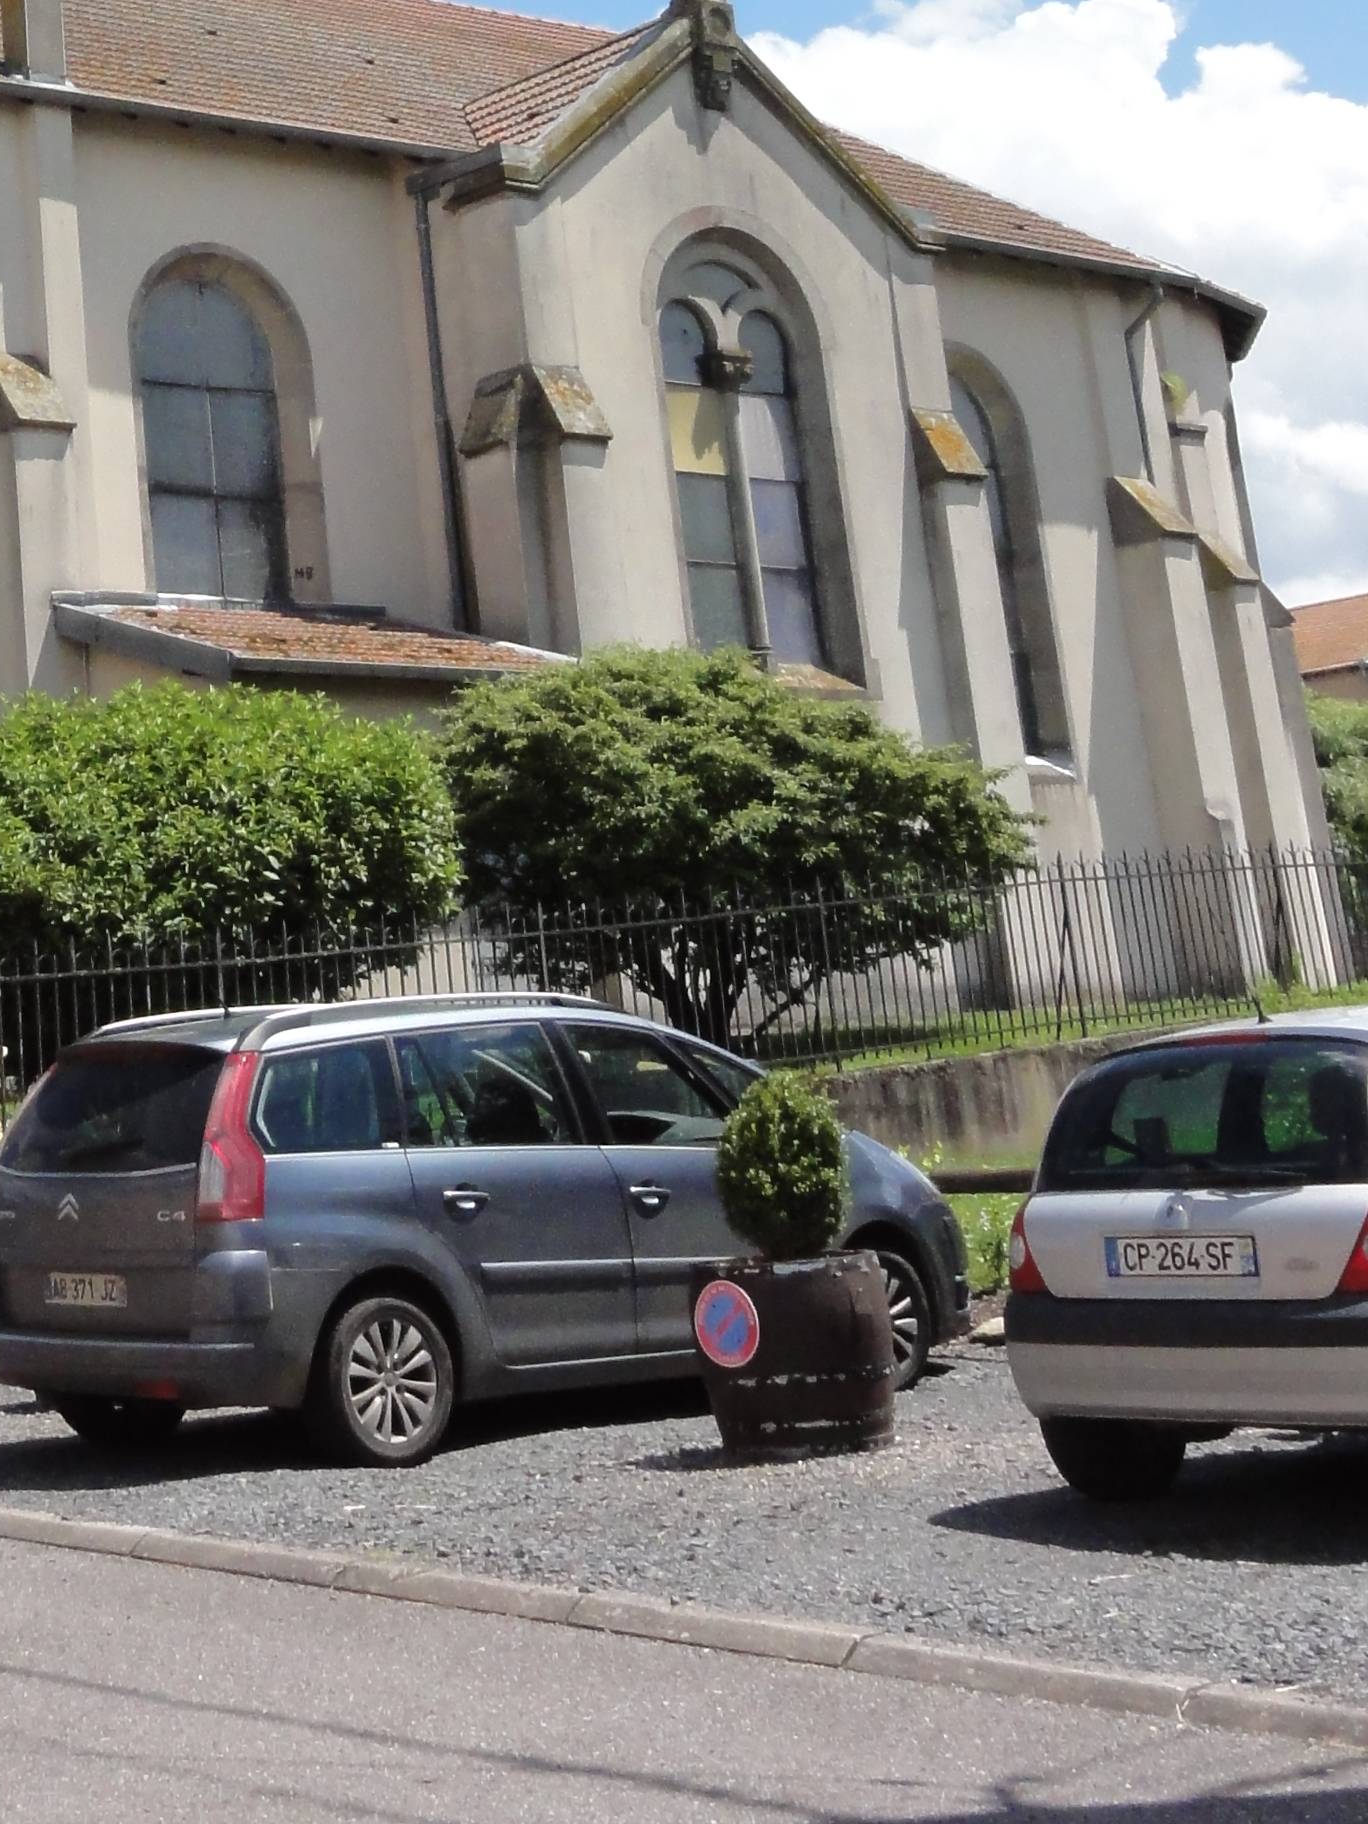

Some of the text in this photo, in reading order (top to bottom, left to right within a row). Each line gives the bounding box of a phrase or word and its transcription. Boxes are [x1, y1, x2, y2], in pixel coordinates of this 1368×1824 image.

[157, 1210, 186, 1222] C4
[1123, 1241, 1235, 1272] CP-264-SF
[71, 1277, 95, 1300] 371
[100, 1278, 116, 1302] JZ
